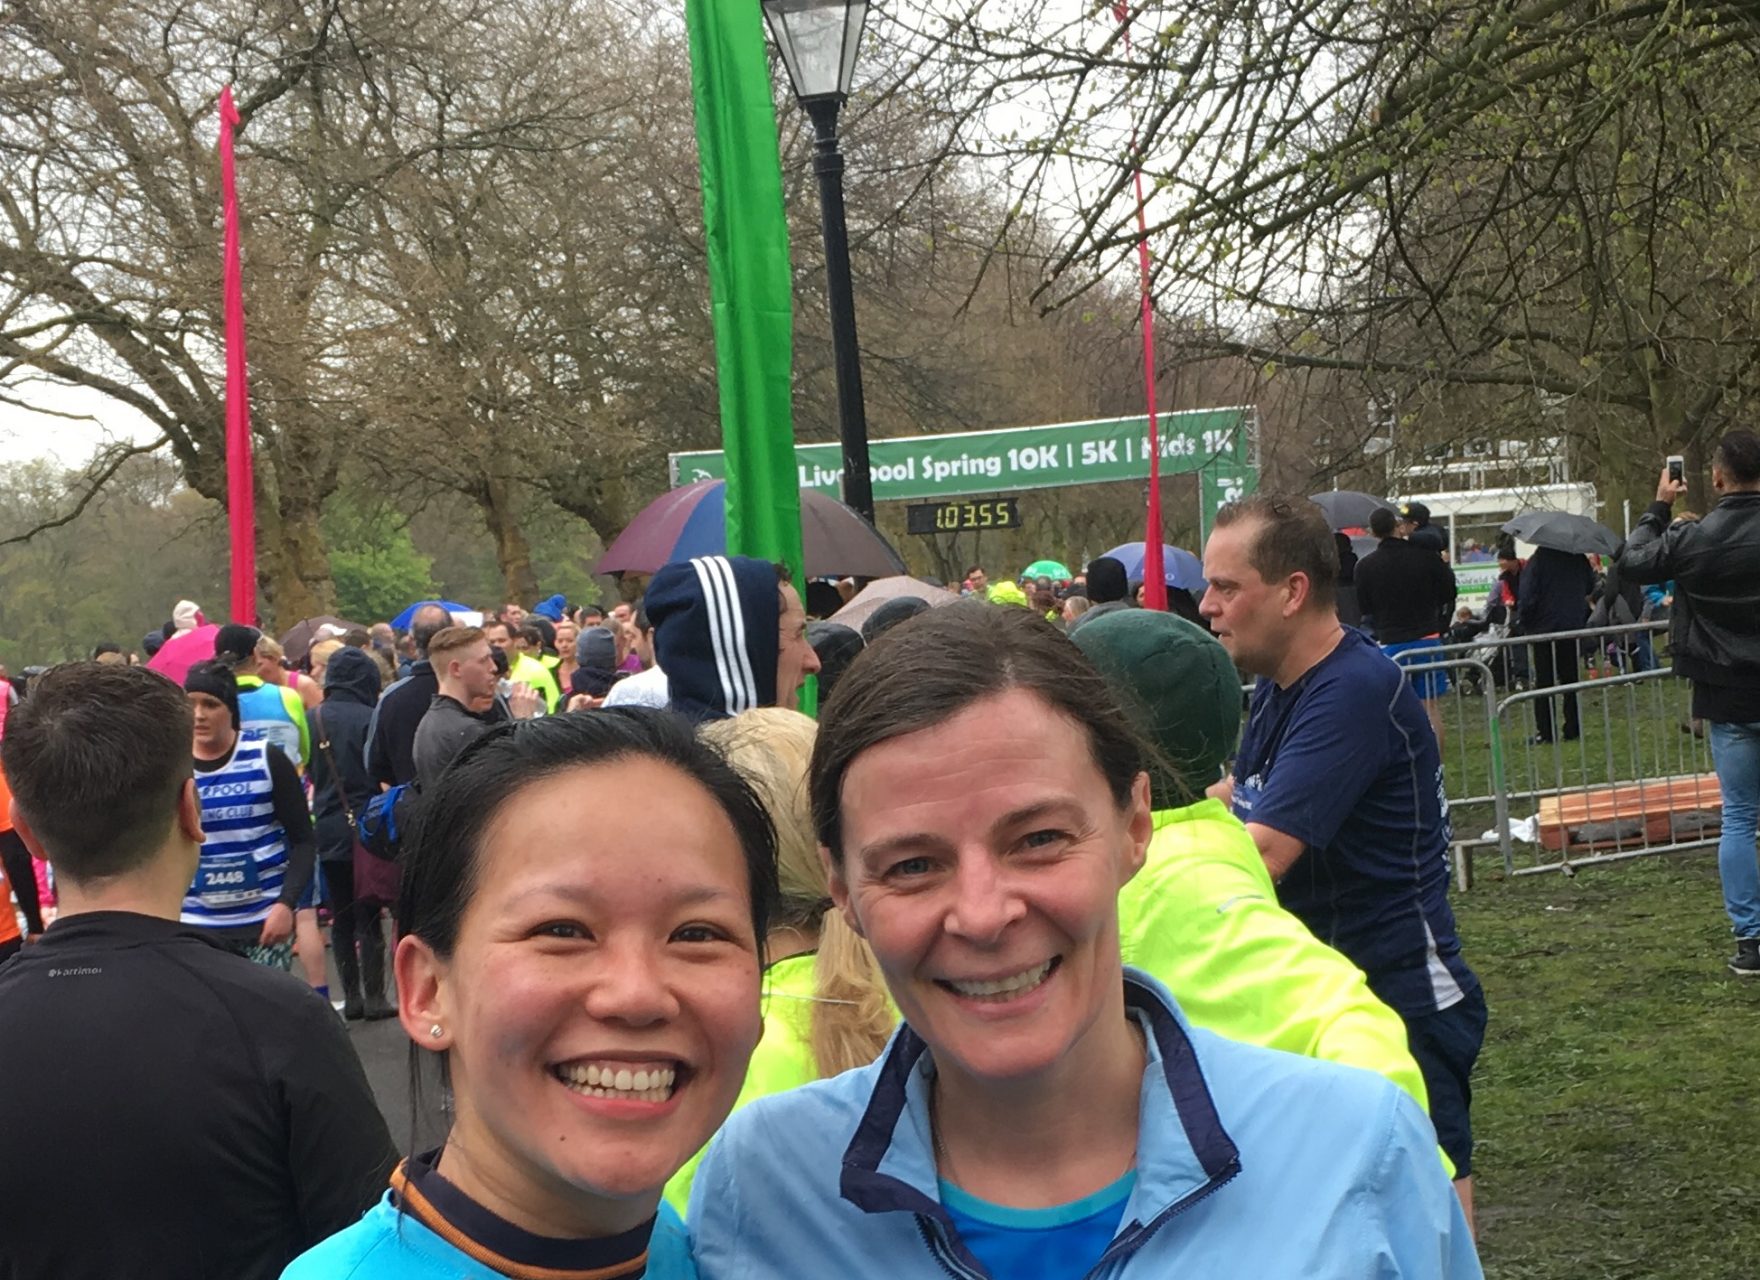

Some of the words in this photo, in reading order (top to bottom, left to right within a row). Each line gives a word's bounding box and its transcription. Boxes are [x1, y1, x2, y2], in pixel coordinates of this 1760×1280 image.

[798, 457, 914, 488] Livool
[921, 453, 1001, 482] Spring
[1007, 445, 1058, 471] 10K
[1081, 439, 1118, 464] 5K
[1202, 429, 1233, 455] 1K
[205, 871, 245, 885] 2448
